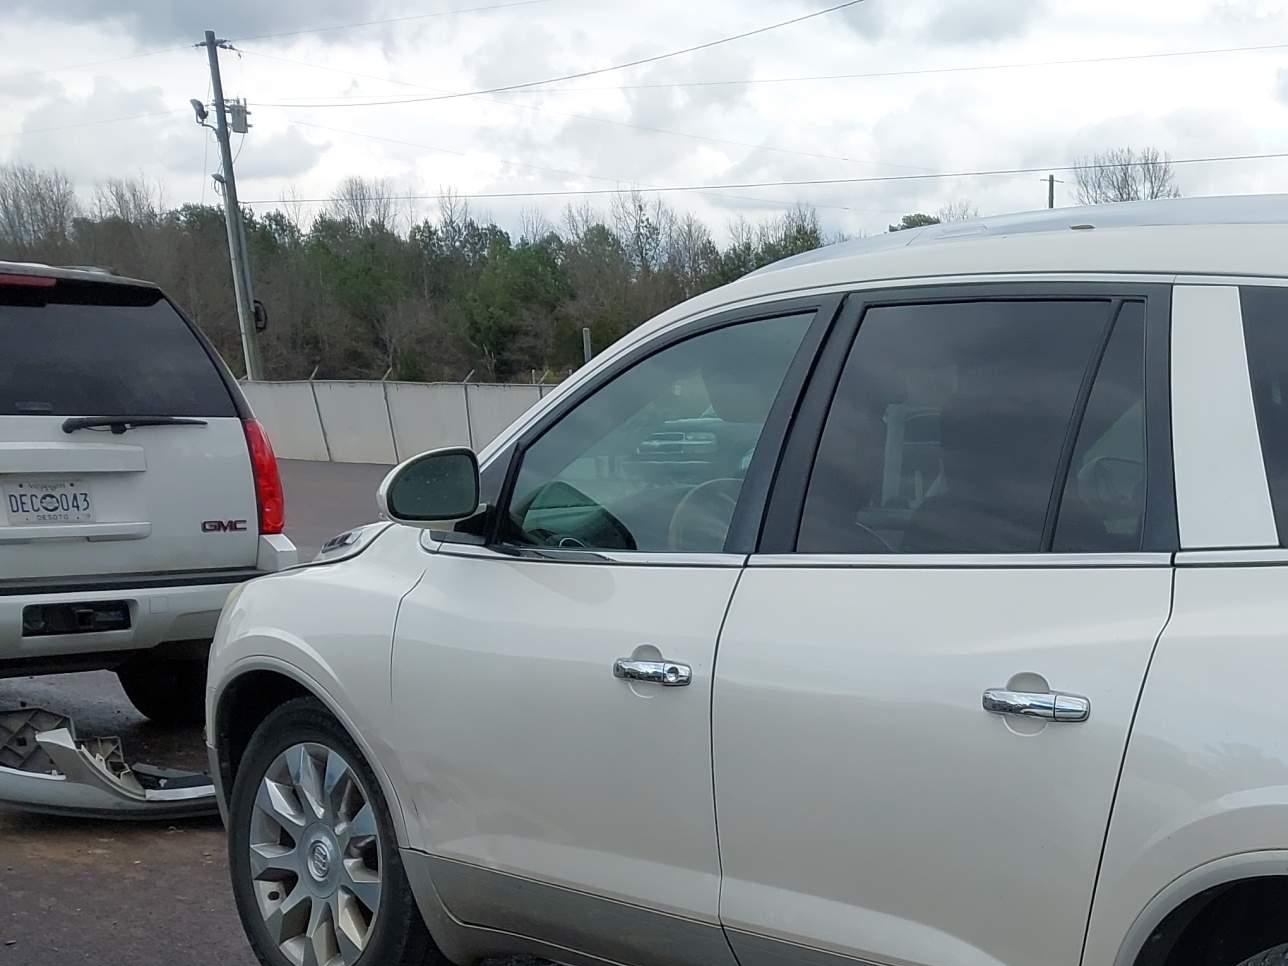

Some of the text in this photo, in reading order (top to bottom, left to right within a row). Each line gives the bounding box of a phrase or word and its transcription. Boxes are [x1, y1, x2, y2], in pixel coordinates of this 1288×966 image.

[8, 492, 90, 513] DEC 043
[201, 519, 248, 533] GMC
